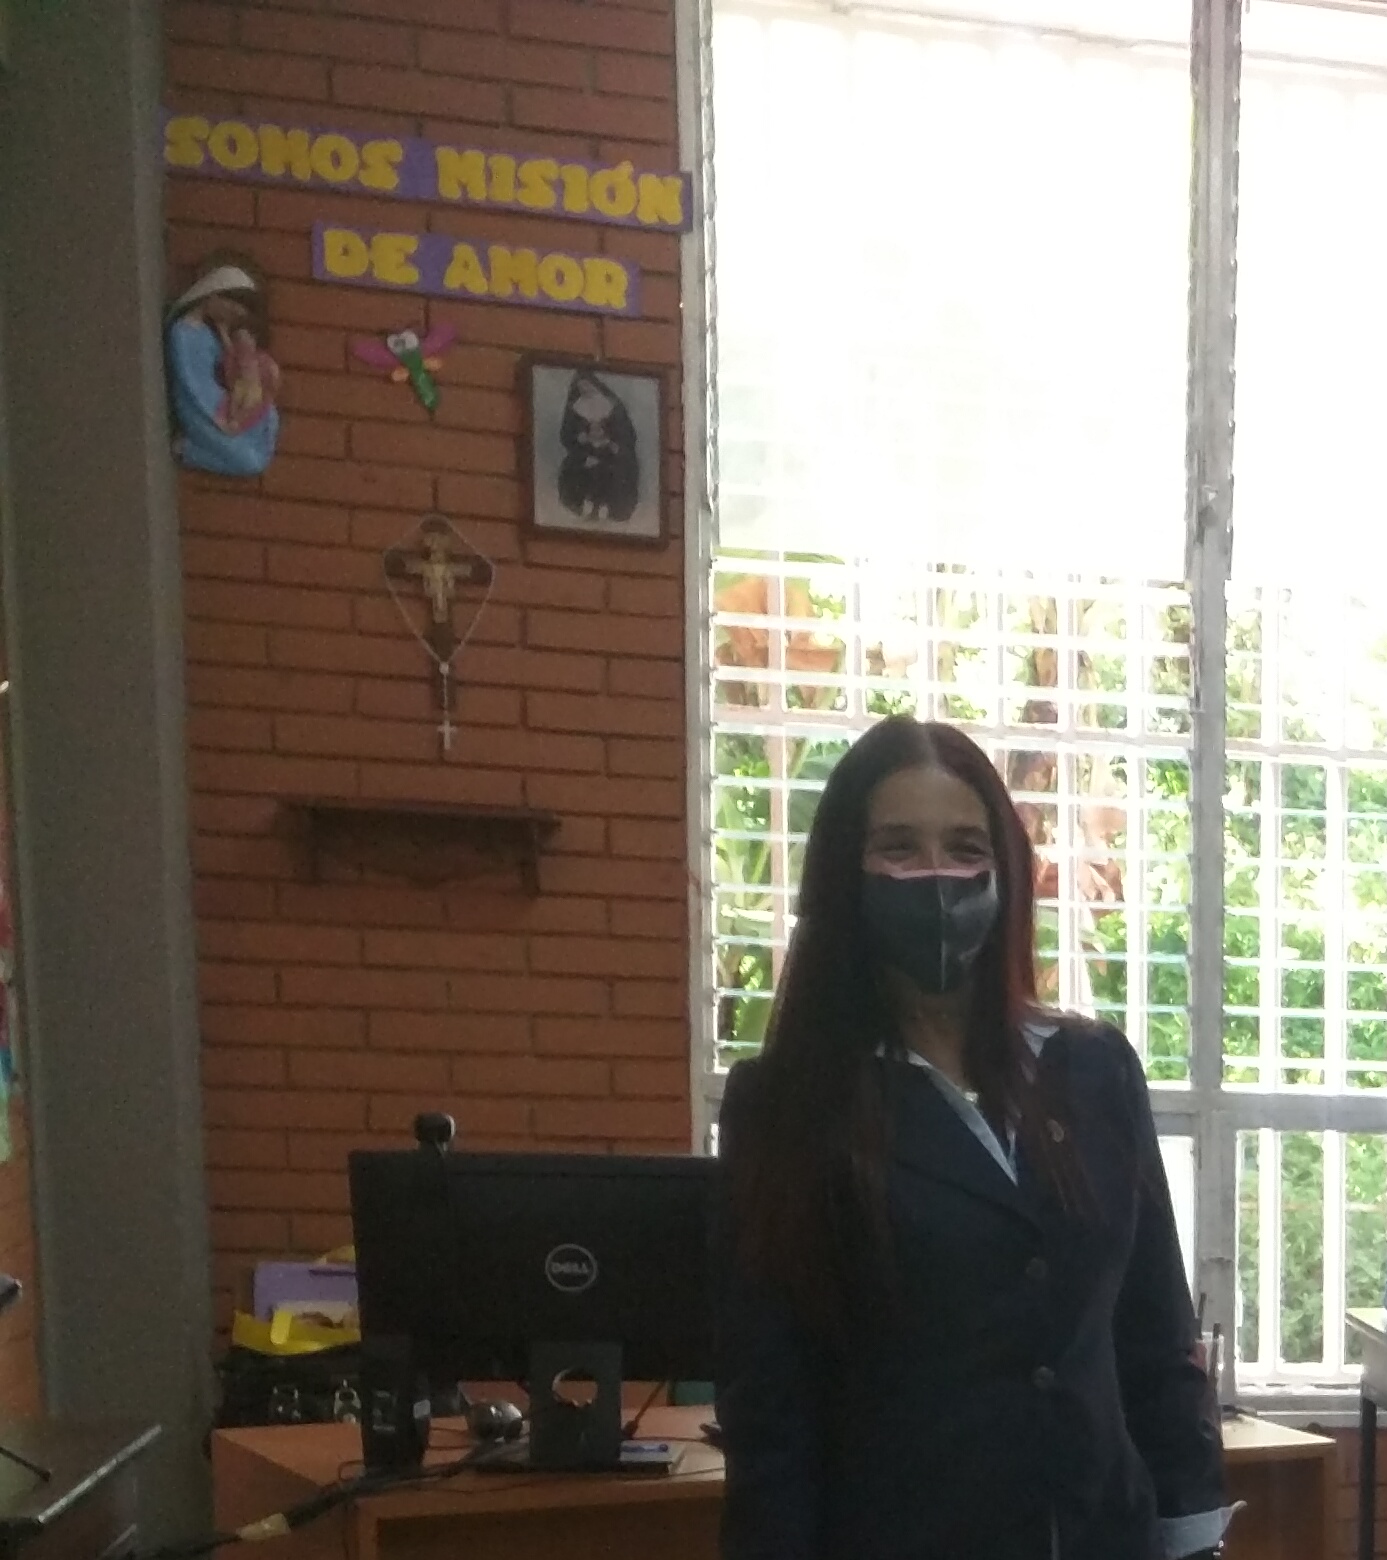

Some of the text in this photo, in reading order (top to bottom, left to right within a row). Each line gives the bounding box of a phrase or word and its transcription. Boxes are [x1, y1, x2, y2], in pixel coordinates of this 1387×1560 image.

[163, 115, 684, 227] SOMOS MISIÓN
[322, 229, 629, 310] DE AMOR
